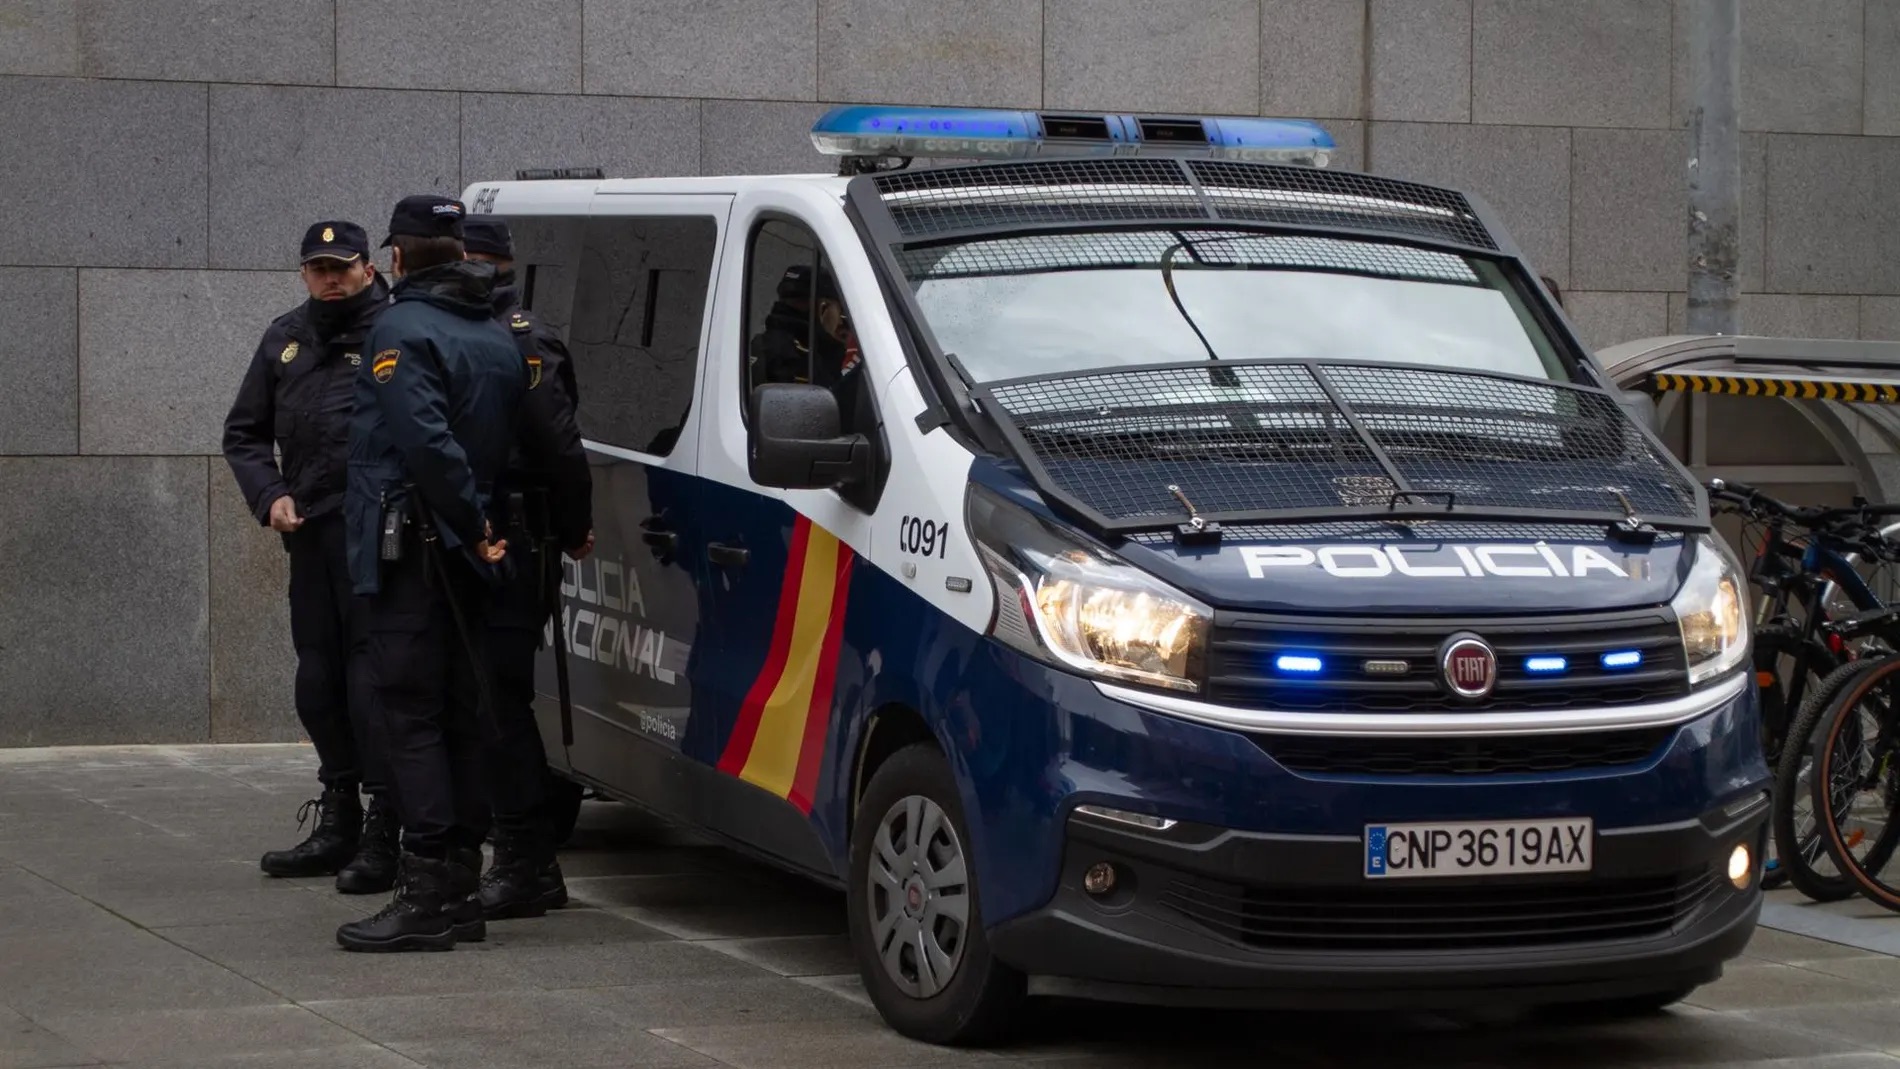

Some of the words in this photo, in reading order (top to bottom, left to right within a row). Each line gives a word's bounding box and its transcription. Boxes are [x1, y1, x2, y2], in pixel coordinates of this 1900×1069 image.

[908, 516, 949, 560] 091
[1237, 540, 1630, 579] POLICÍA
[560, 550, 646, 619] OLICÍA
[1456, 657, 1485, 683] FIAT
[1372, 856, 1382, 868] E
[1386, 824, 1586, 870] CNP3619AX
